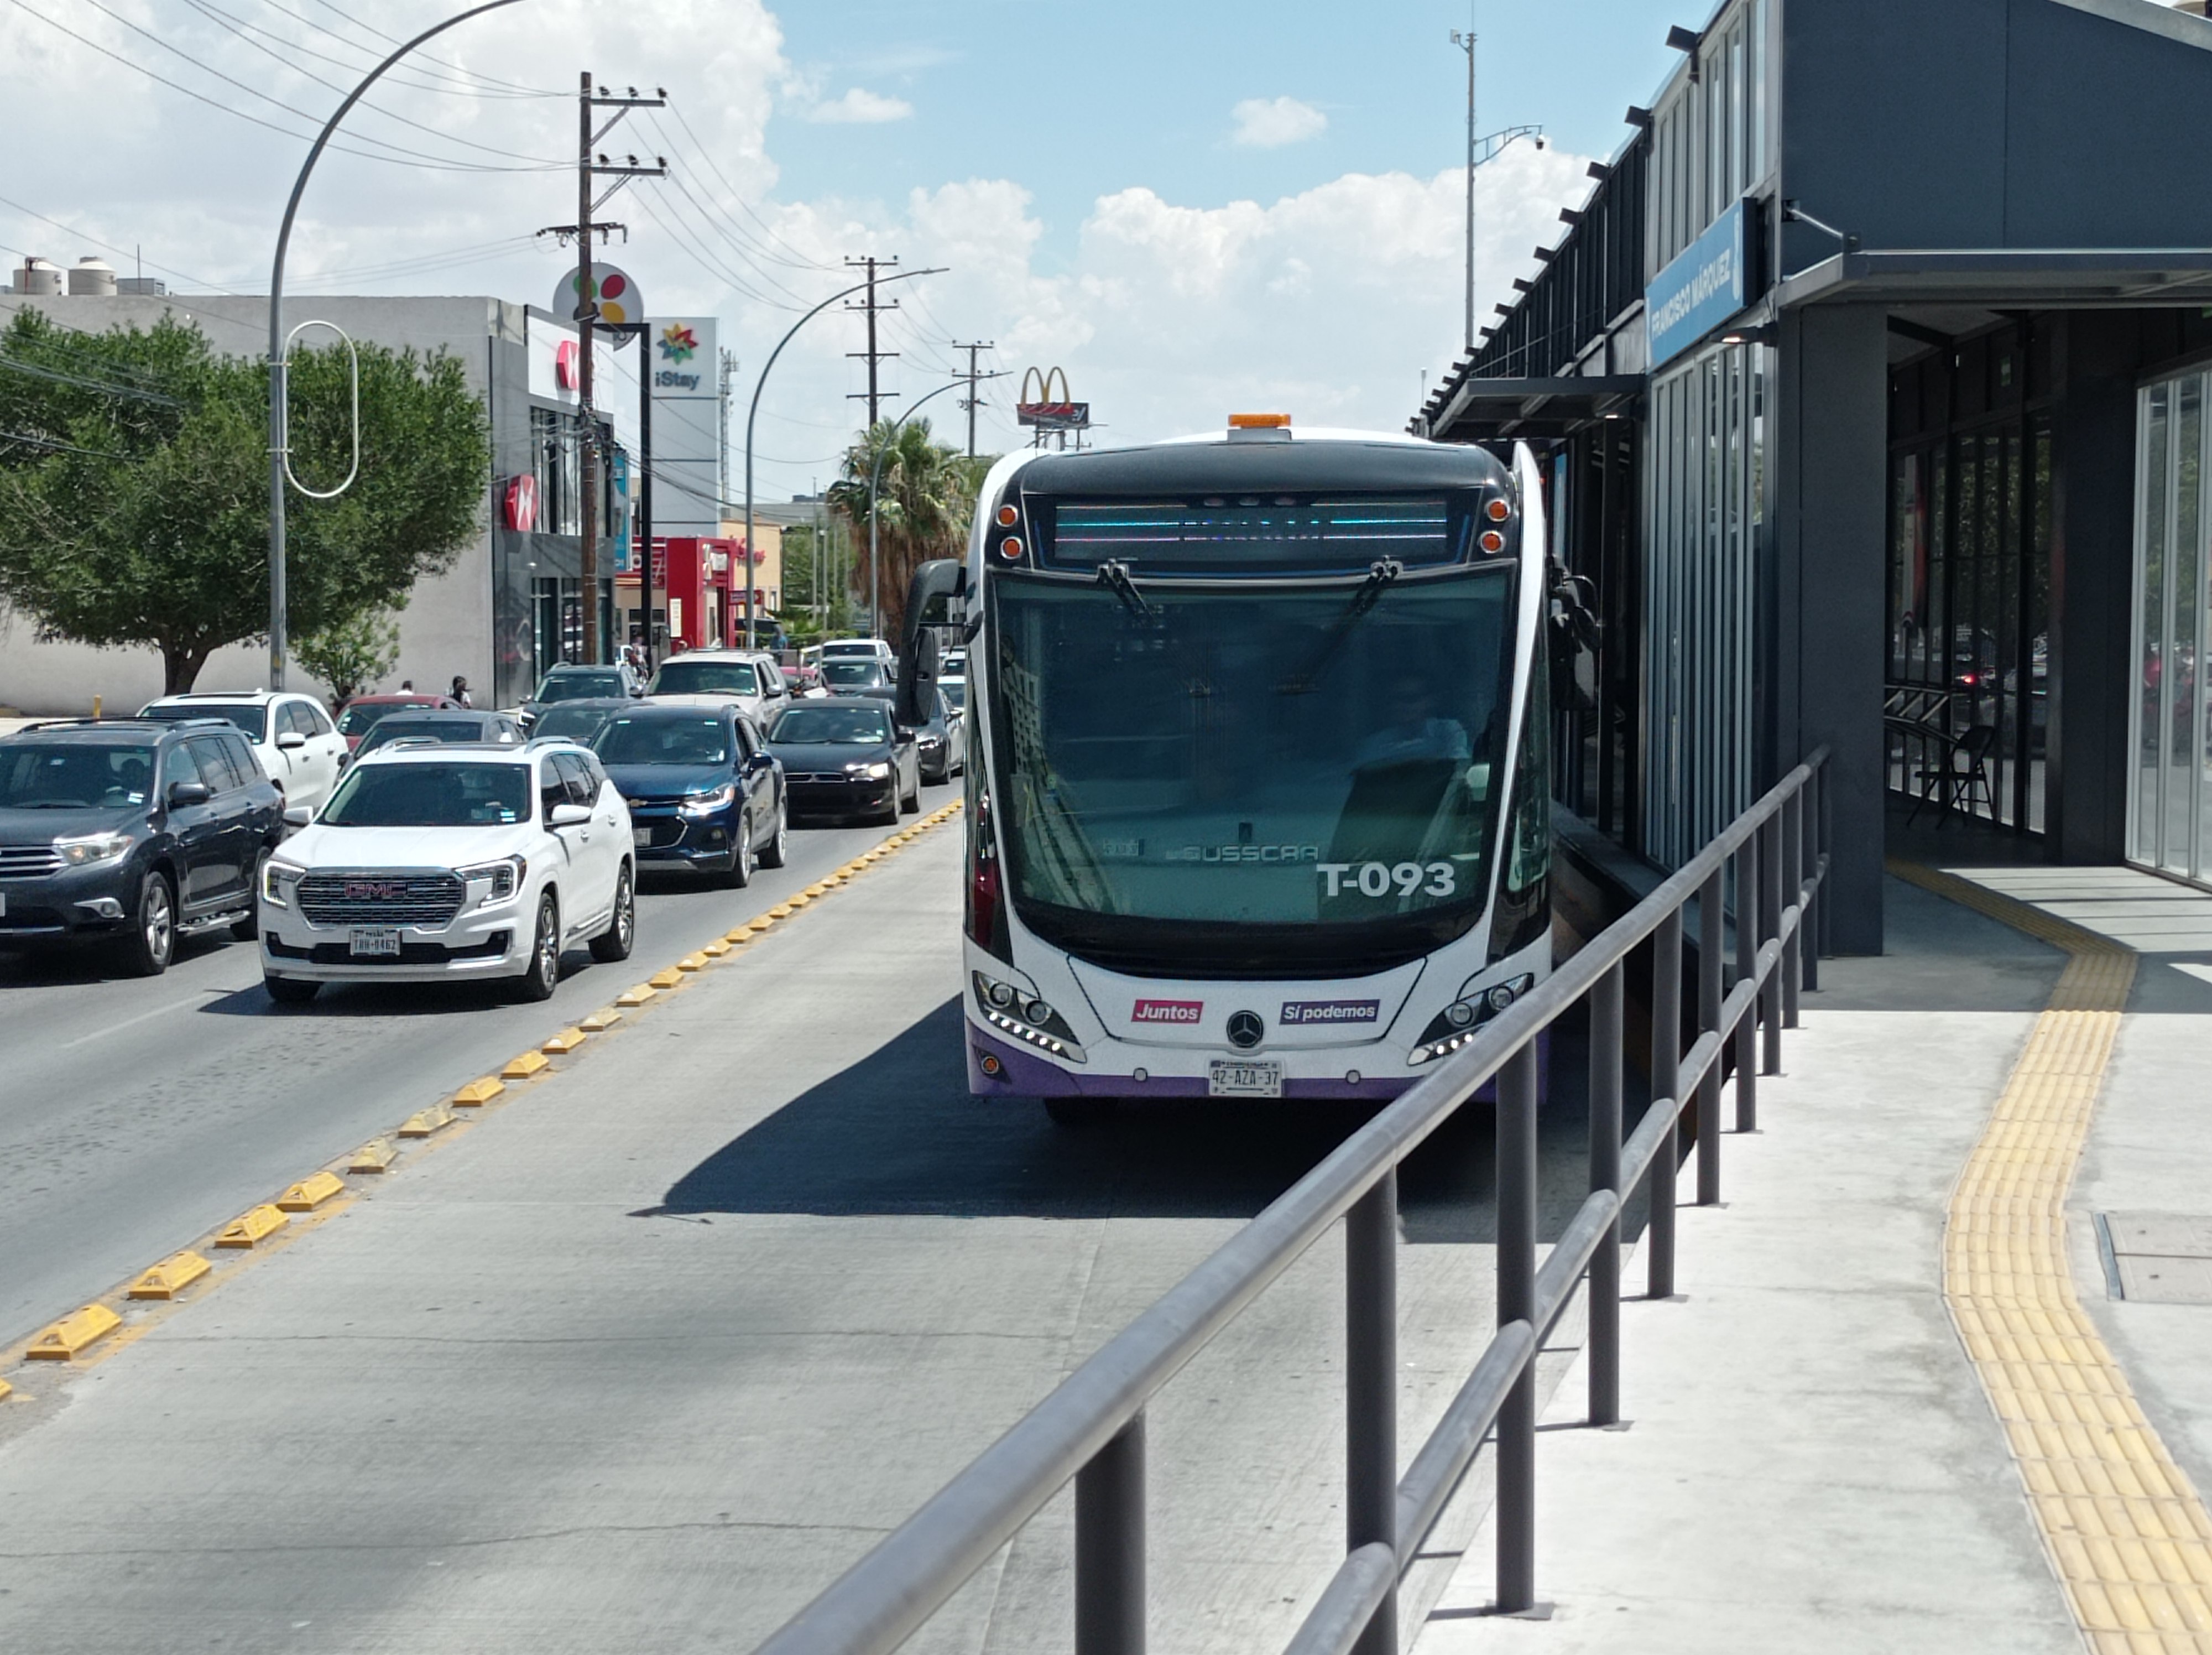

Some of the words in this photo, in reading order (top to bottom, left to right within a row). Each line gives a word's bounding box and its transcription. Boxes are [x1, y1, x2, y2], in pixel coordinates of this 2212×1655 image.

[1651, 283, 1691, 341] FRANCISCO
[655, 371, 700, 391] iStay
[1316, 861, 1455, 897] T-093
[344, 883, 408, 897] GMC
[1136, 1003, 1198, 1020] Juntos
[1284, 1005, 1301, 1019] Sí
[1302, 1005, 1376, 1022] podemos
